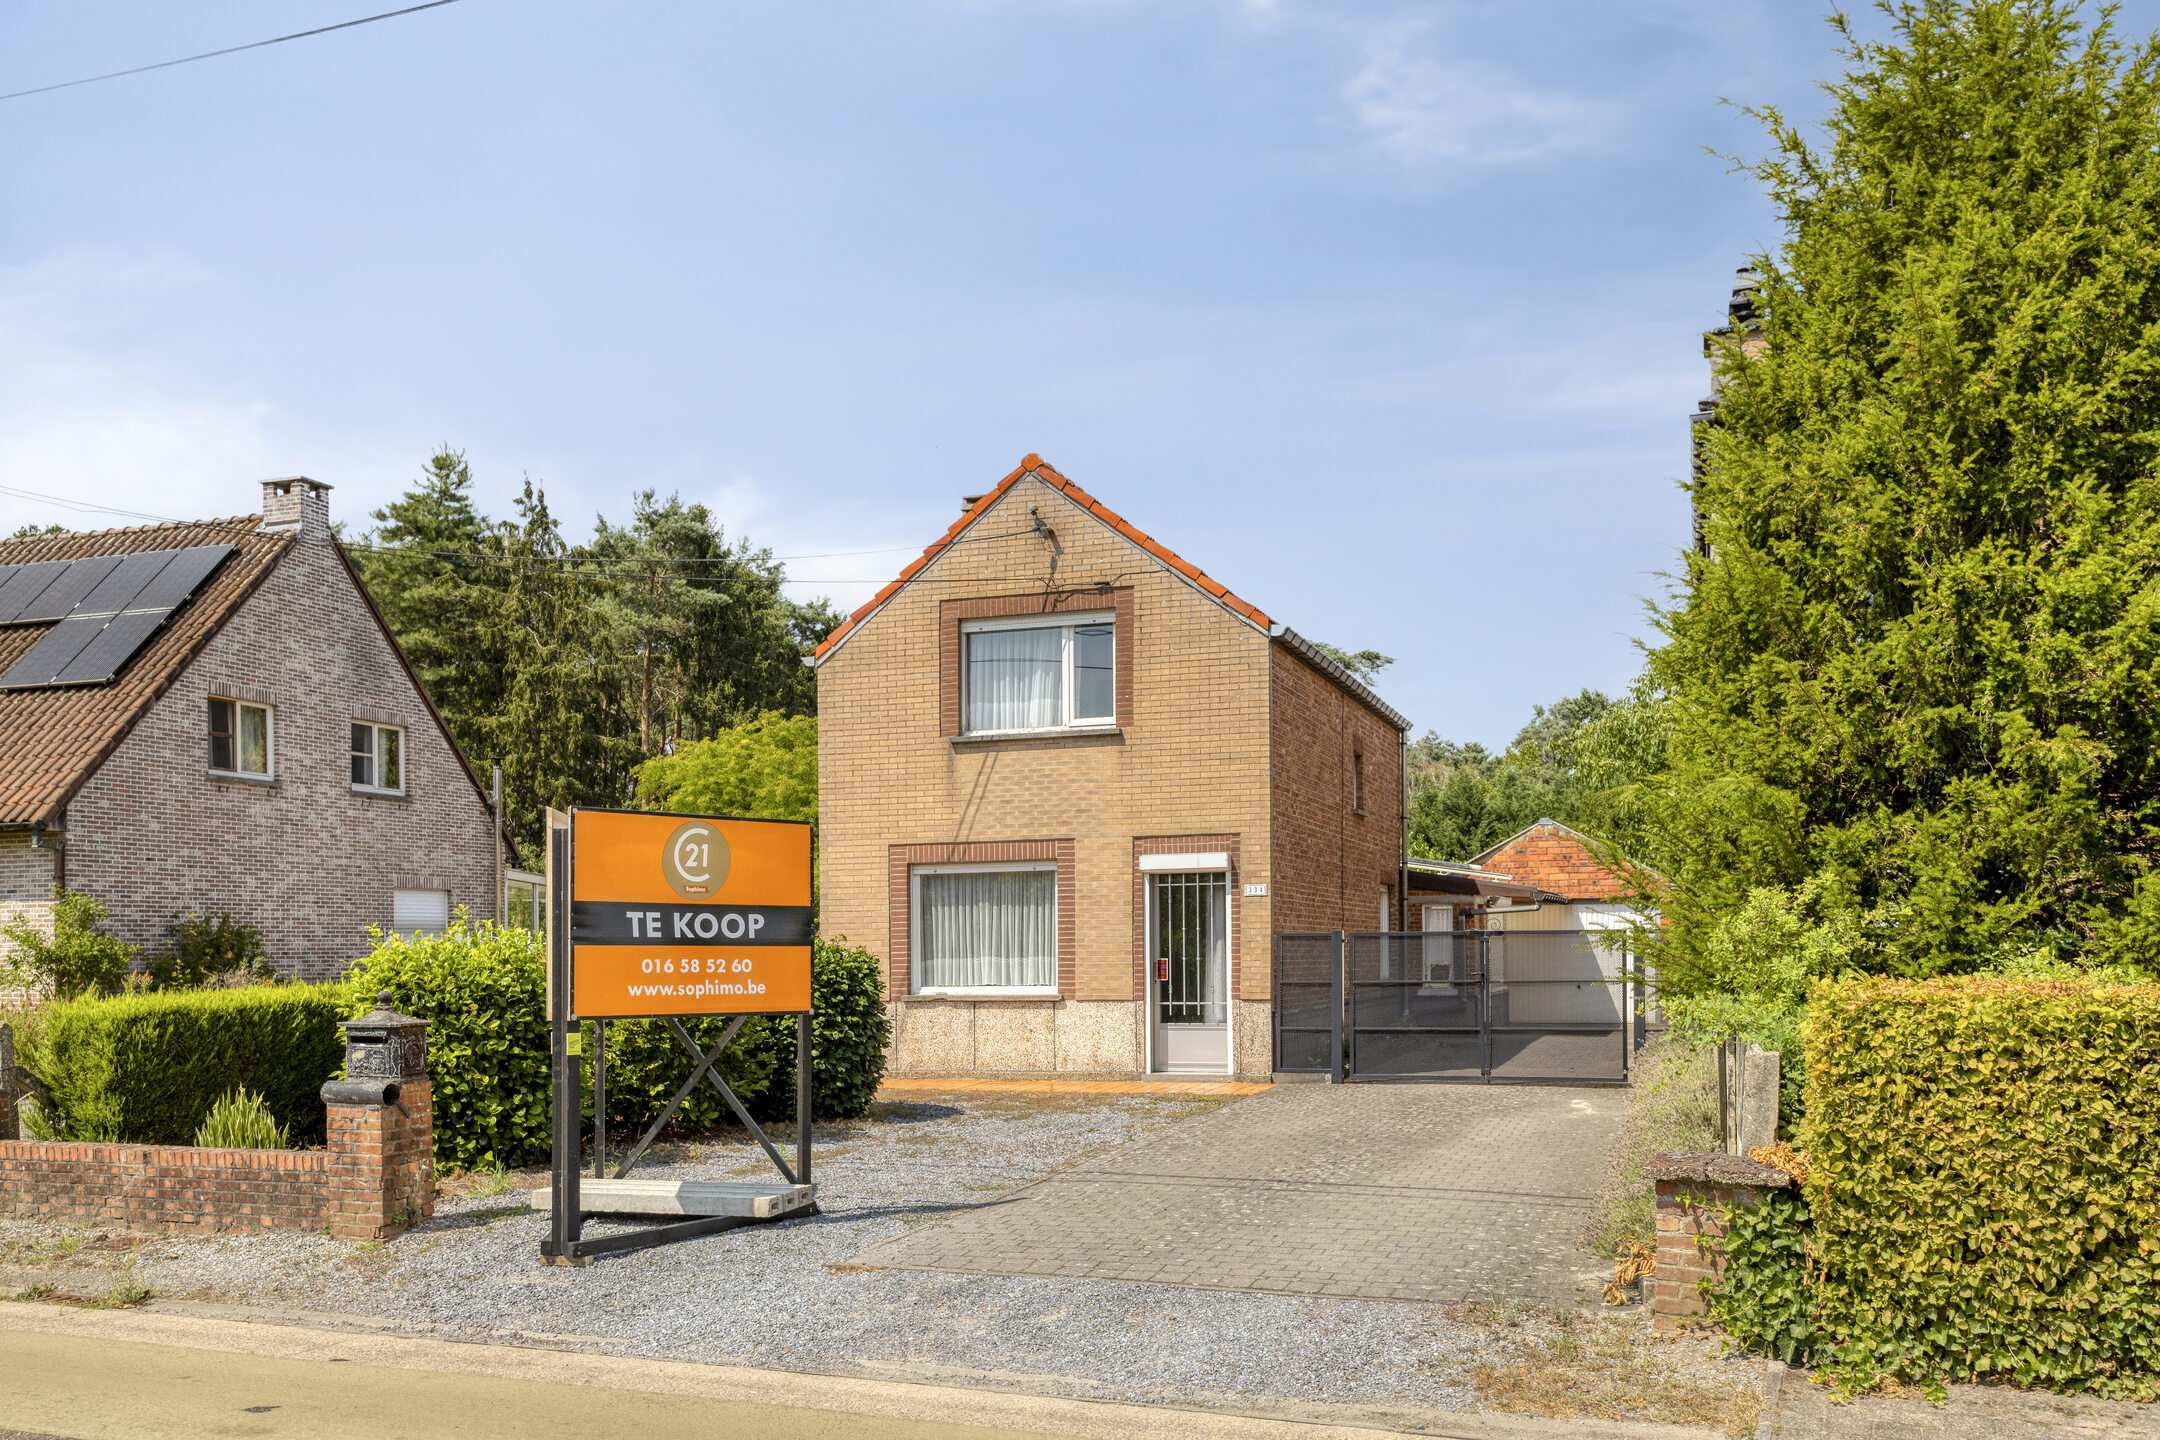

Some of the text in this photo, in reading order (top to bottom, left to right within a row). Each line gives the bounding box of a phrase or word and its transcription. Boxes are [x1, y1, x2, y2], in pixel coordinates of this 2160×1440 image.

[626, 911, 765, 939] TE KOOP
[641, 958, 752, 973] 016 58 52 60
[627, 978, 766, 999] www.sophimo.be
